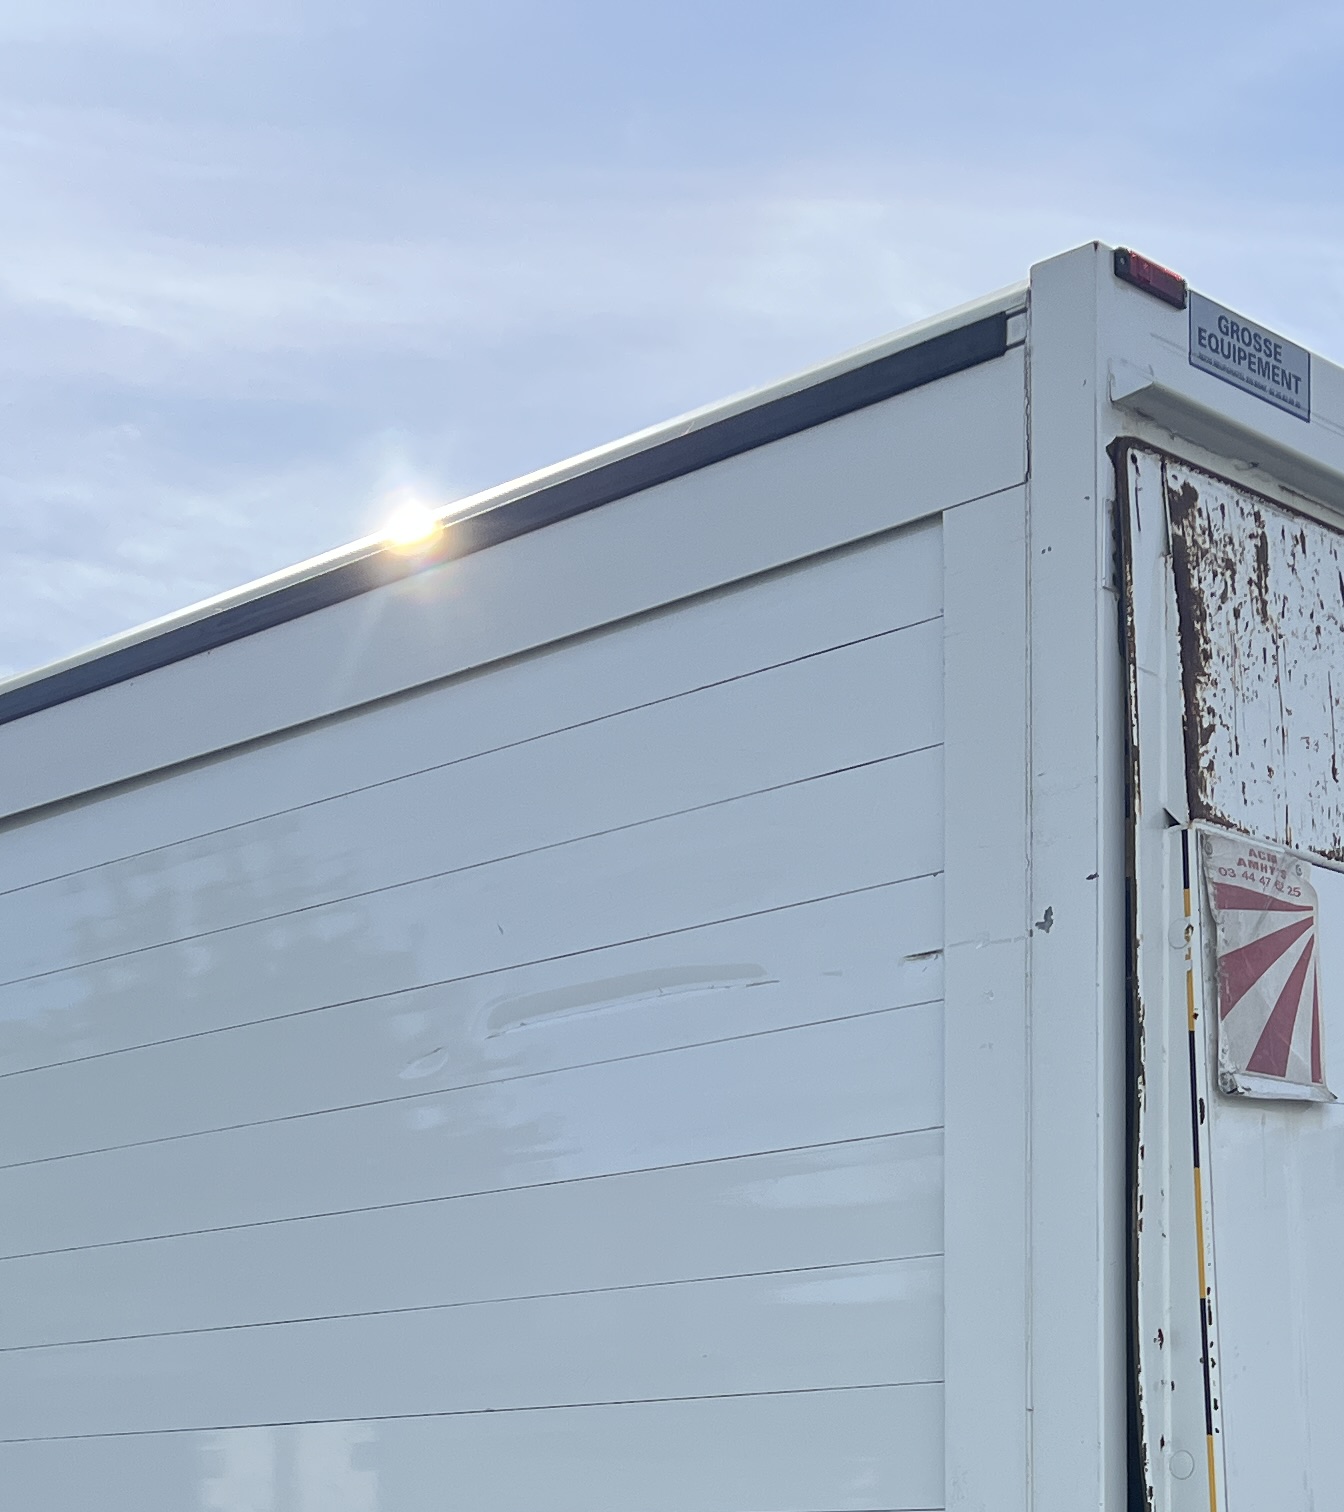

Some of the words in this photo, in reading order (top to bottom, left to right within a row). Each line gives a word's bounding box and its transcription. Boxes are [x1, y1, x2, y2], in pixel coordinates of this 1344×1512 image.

[1197, 326, 1302, 395] EQUIPEMENT
[1217, 314, 1283, 364] GROSSE
[1218, 866, 1236, 878] 03
[1241, 870, 1256, 882] 44
[1259, 875, 1271, 888] 47
